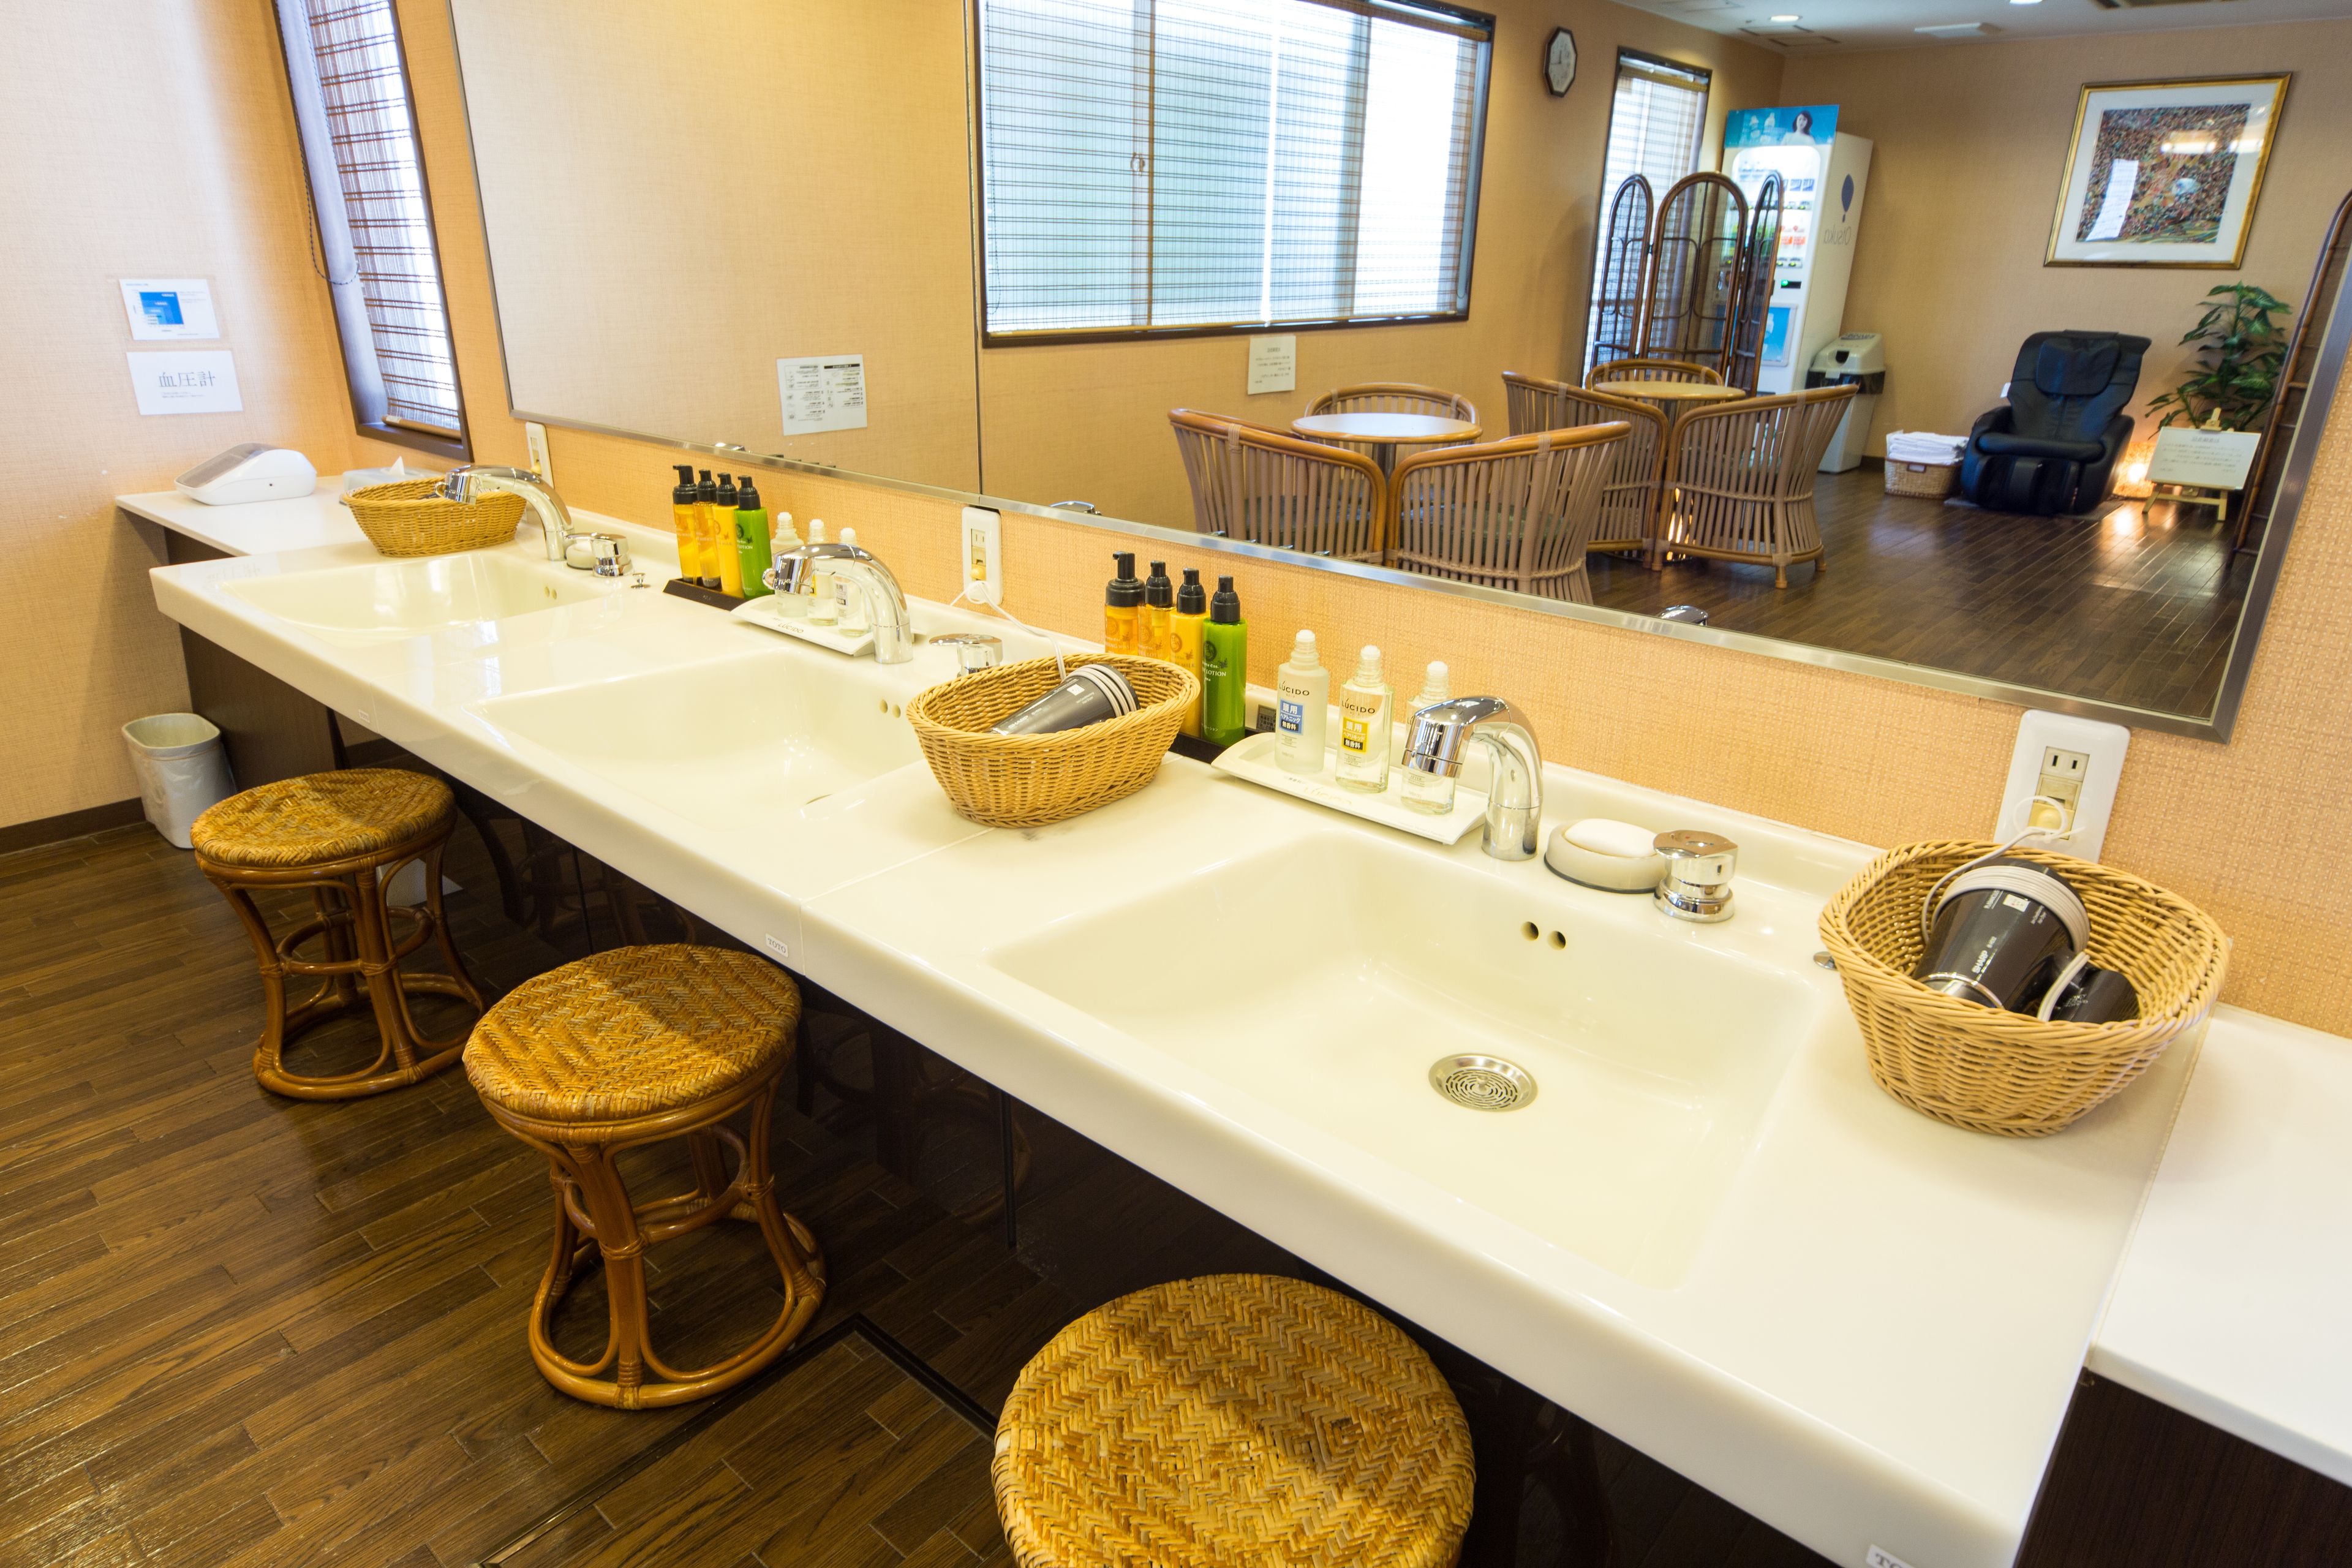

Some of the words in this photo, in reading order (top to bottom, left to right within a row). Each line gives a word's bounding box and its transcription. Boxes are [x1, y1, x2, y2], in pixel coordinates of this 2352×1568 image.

[159, 371, 216, 387] 血圧計
[1279, 680, 1310, 696] LÚCIDO
[1341, 698, 1376, 714] LÚCIDO
[1280, 713, 1301, 723] ヘアトニック
[1282, 720, 1296, 731] 無香料
[1345, 739, 1361, 750] 無香料
[767, 937, 786, 954] TOTO
[1971, 950, 1989, 974] SHARP
